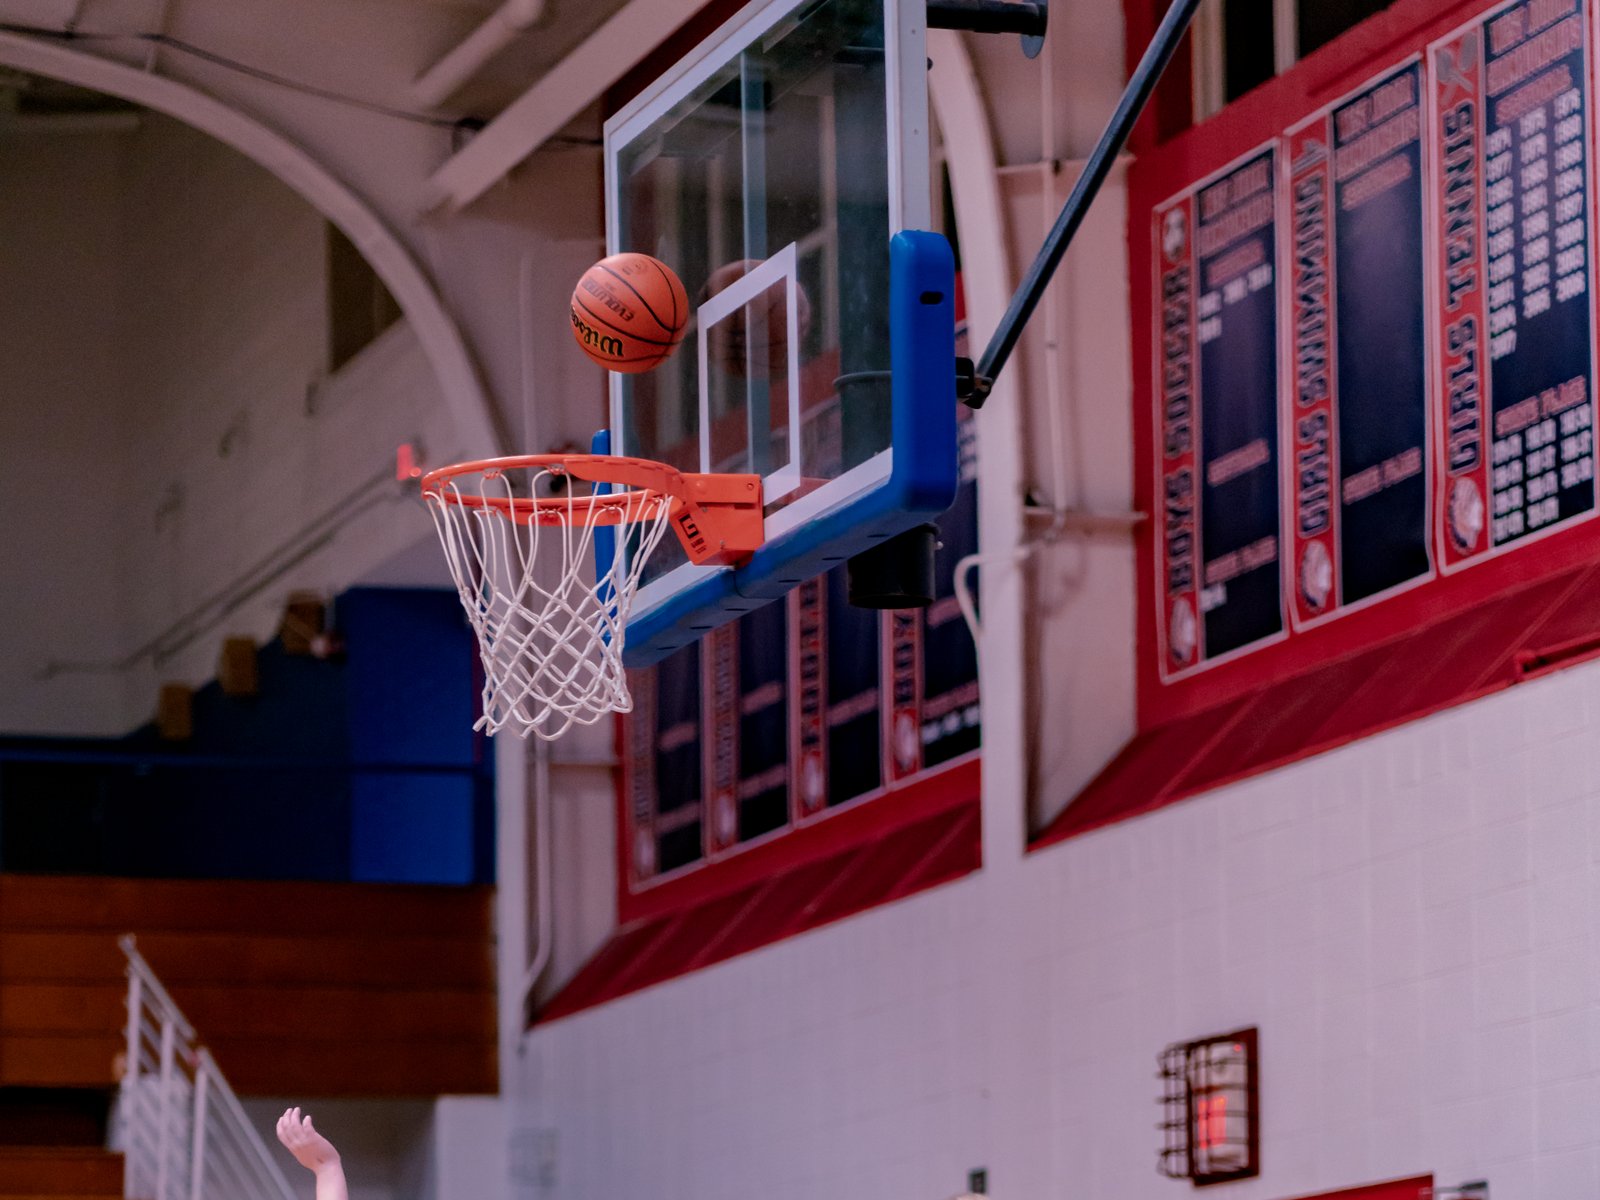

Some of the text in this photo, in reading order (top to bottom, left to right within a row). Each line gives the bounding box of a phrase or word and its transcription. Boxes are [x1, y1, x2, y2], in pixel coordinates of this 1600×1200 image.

[1294, 174, 1330, 538] GIRLS SWIMMING
[1442, 101, 1480, 475] GIRLS TENNIS
[1166, 466, 1194, 595] BOYS
